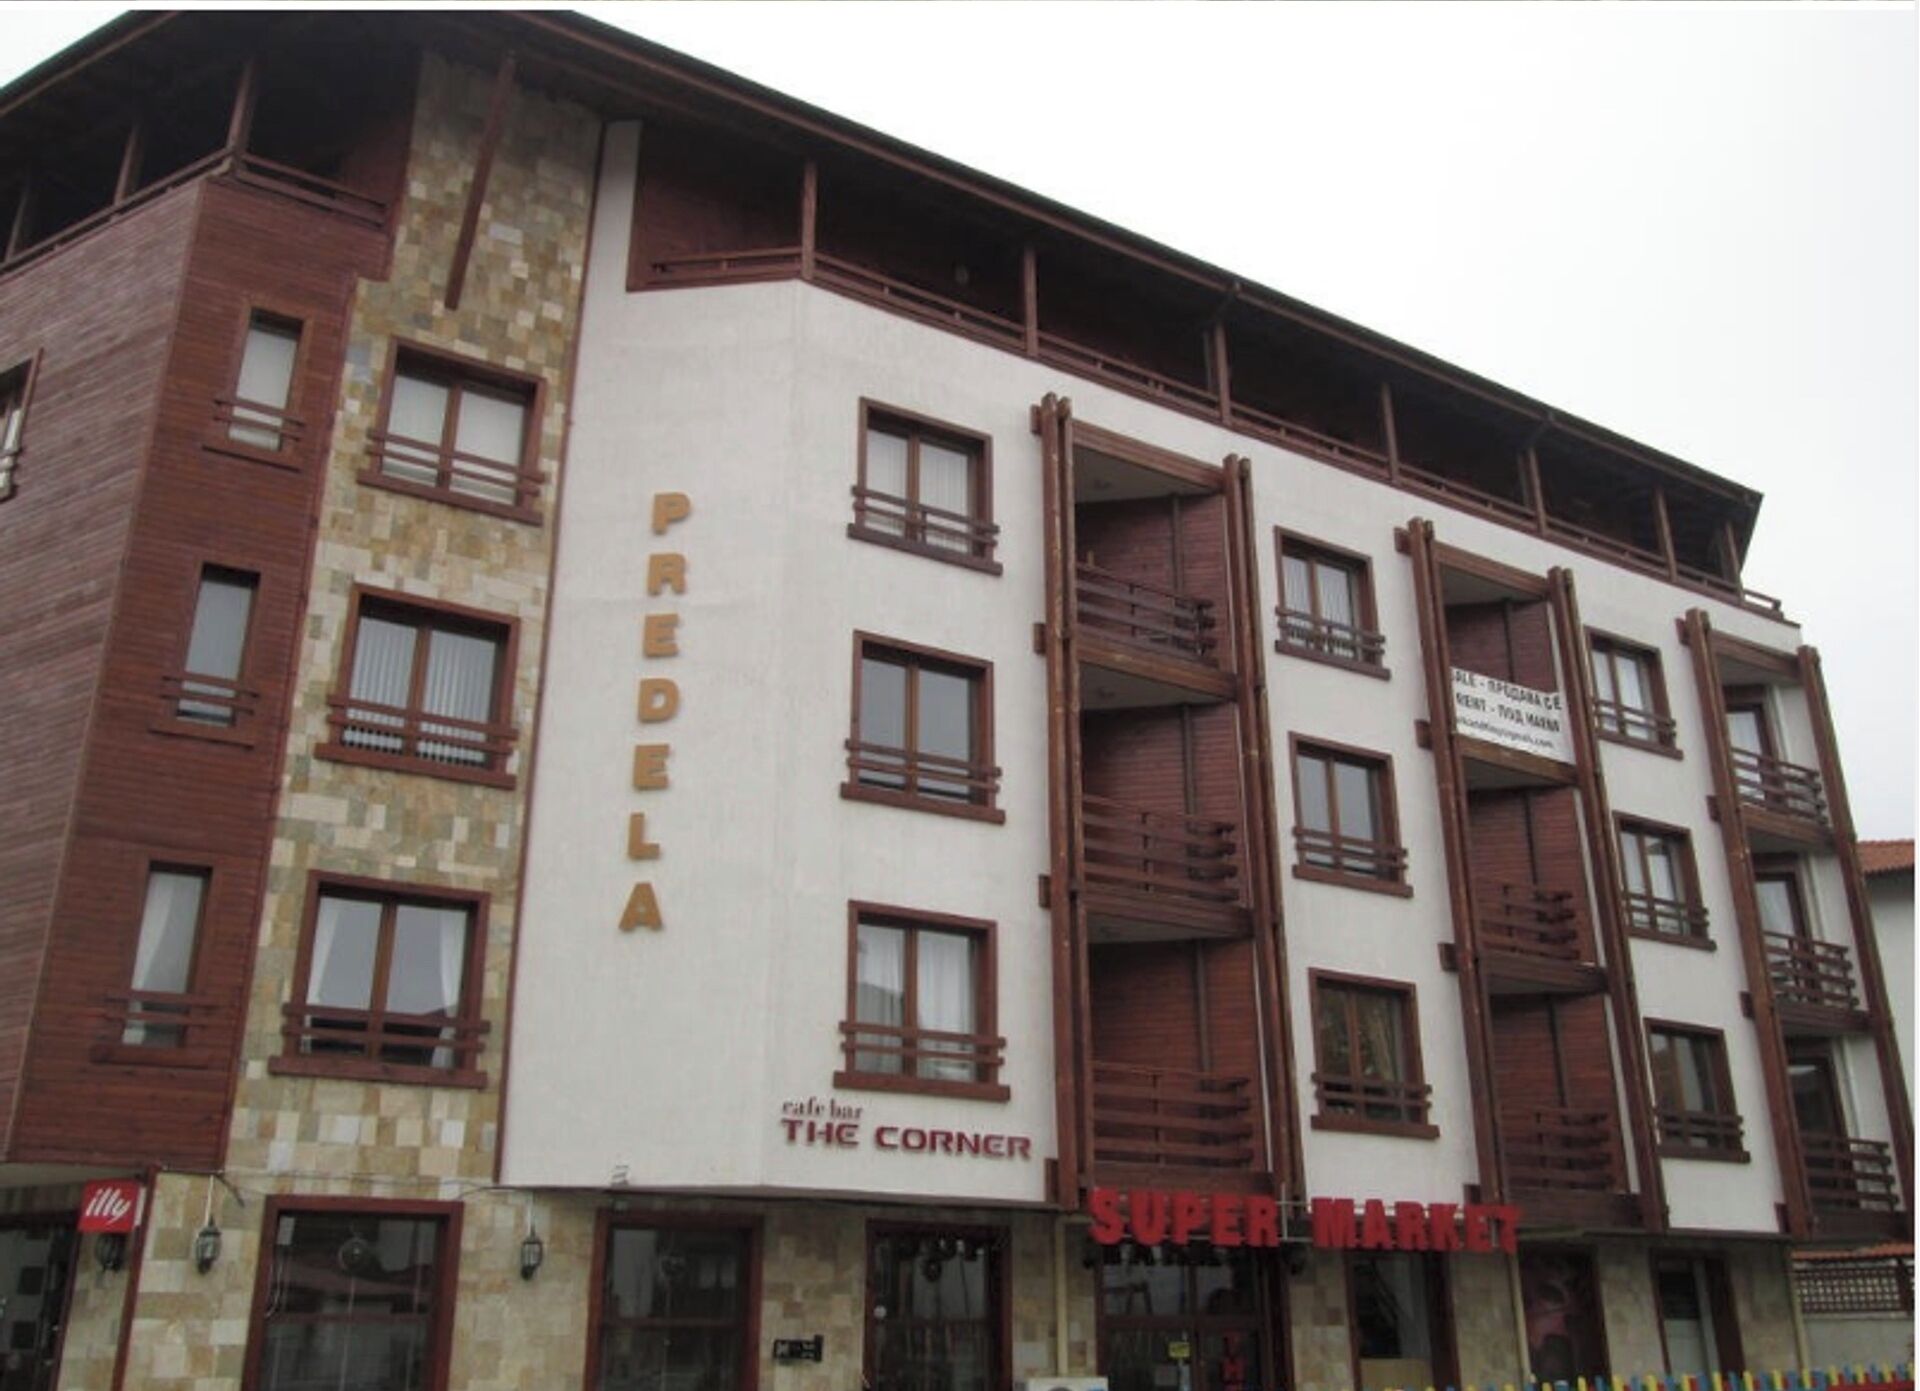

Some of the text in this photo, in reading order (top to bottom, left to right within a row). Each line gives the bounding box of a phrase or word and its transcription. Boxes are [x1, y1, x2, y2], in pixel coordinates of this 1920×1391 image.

[1452, 669, 1477, 688] ALE
[619, 491, 692, 932] PREDELA
[782, 1096, 864, 1120] cafe bar
[781, 1119, 1032, 1159] THE CORNER
[85, 1186, 132, 1226] illy
[1088, 1186, 1520, 1255] SUPER MARKET
